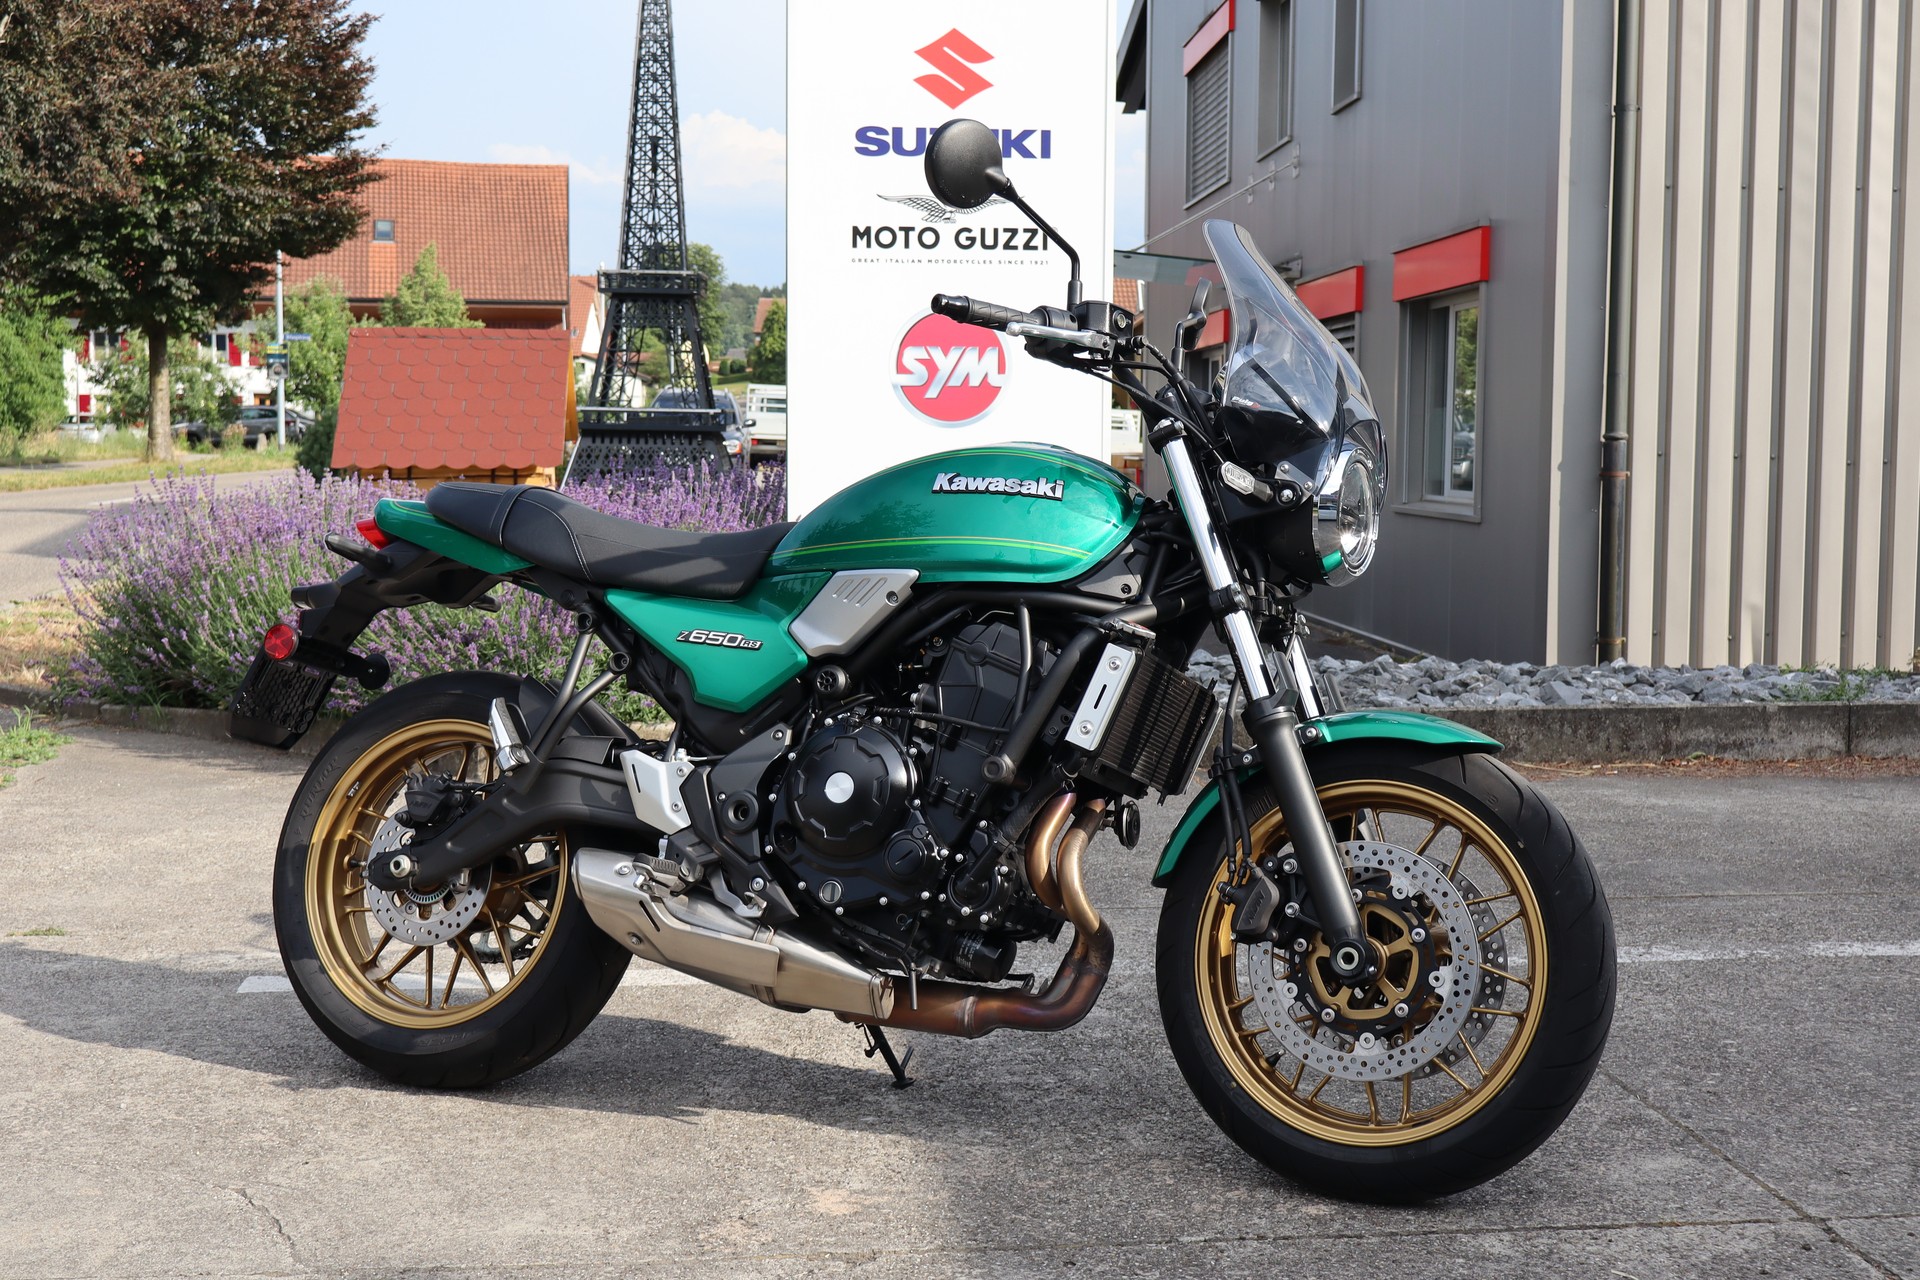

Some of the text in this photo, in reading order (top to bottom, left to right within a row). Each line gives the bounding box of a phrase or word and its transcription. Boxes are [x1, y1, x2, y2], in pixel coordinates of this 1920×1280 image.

[854, 126, 1051, 159] SUKI
[852, 226, 1048, 251] MOTO GUZZI
[894, 346, 1007, 399] SYM
[932, 472, 1065, 501] Kawasaki
